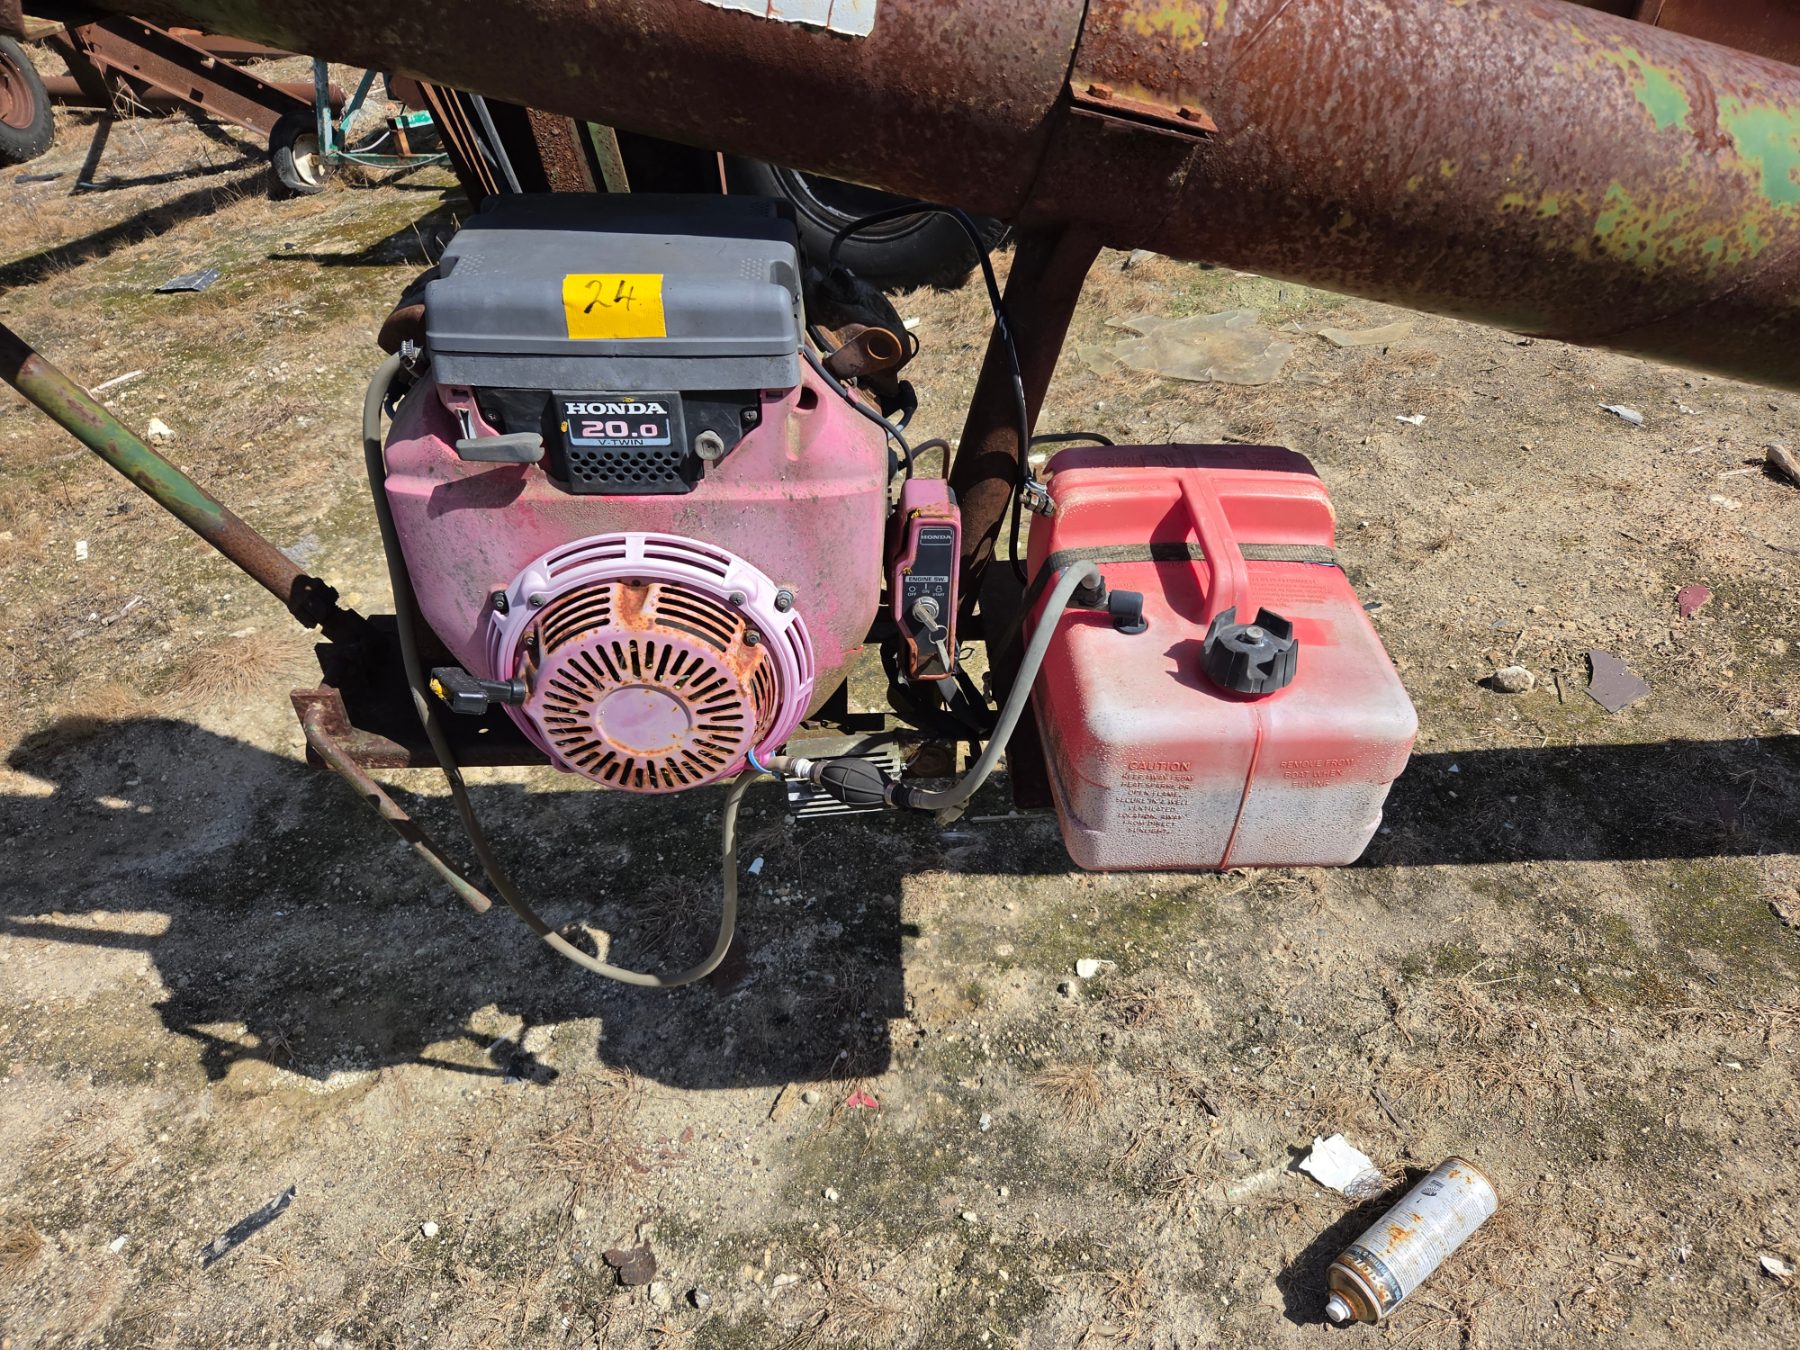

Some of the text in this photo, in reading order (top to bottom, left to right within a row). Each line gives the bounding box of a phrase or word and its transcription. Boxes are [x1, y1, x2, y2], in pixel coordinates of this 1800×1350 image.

[565, 402, 668, 415] HONDA
[581, 420, 659, 438] 20.0
[1127, 760, 1191, 772] CAUTION
[1279, 757, 1355, 769] REMOVE FROM
[1283, 769, 1343, 780] BOAT WHEN
